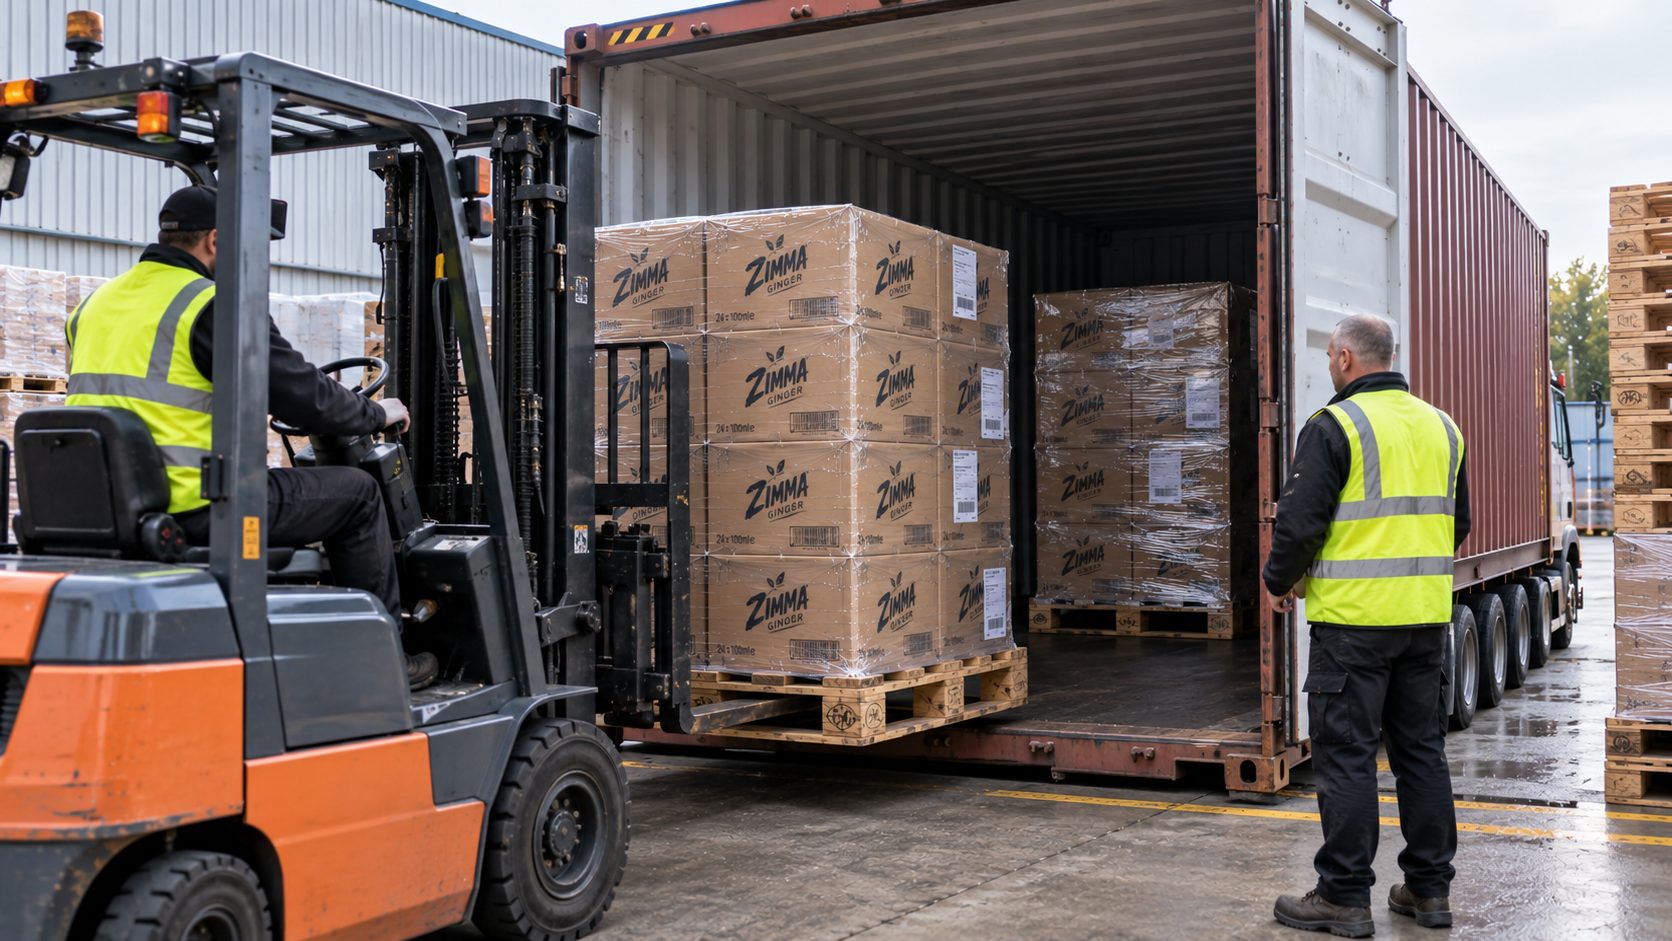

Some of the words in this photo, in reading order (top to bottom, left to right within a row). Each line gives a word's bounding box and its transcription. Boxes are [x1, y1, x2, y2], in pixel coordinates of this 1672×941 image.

[612, 257, 669, 308] ZIMMA
[745, 244, 808, 297] ZIMMA
[767, 273, 802, 293] GINGER
[875, 255, 914, 296] ZIMMA
[632, 286, 664, 305] GINGER
[1060, 316, 1104, 351] ZIMMA
[745, 357, 808, 408] ZIMMA
[767, 386, 803, 405] GINGER
[875, 364, 915, 408] ZIMMA
[1060, 393, 1104, 427] ZIMMA
[745, 471, 809, 520] ZIMMA
[876, 473, 915, 520] ZIMMA
[1061, 469, 1104, 501] ZIMMA
[1061, 544, 1104, 576] ZIMMA
[745, 584, 809, 632] ZIMMA
[877, 582, 916, 633] ZIMMA
